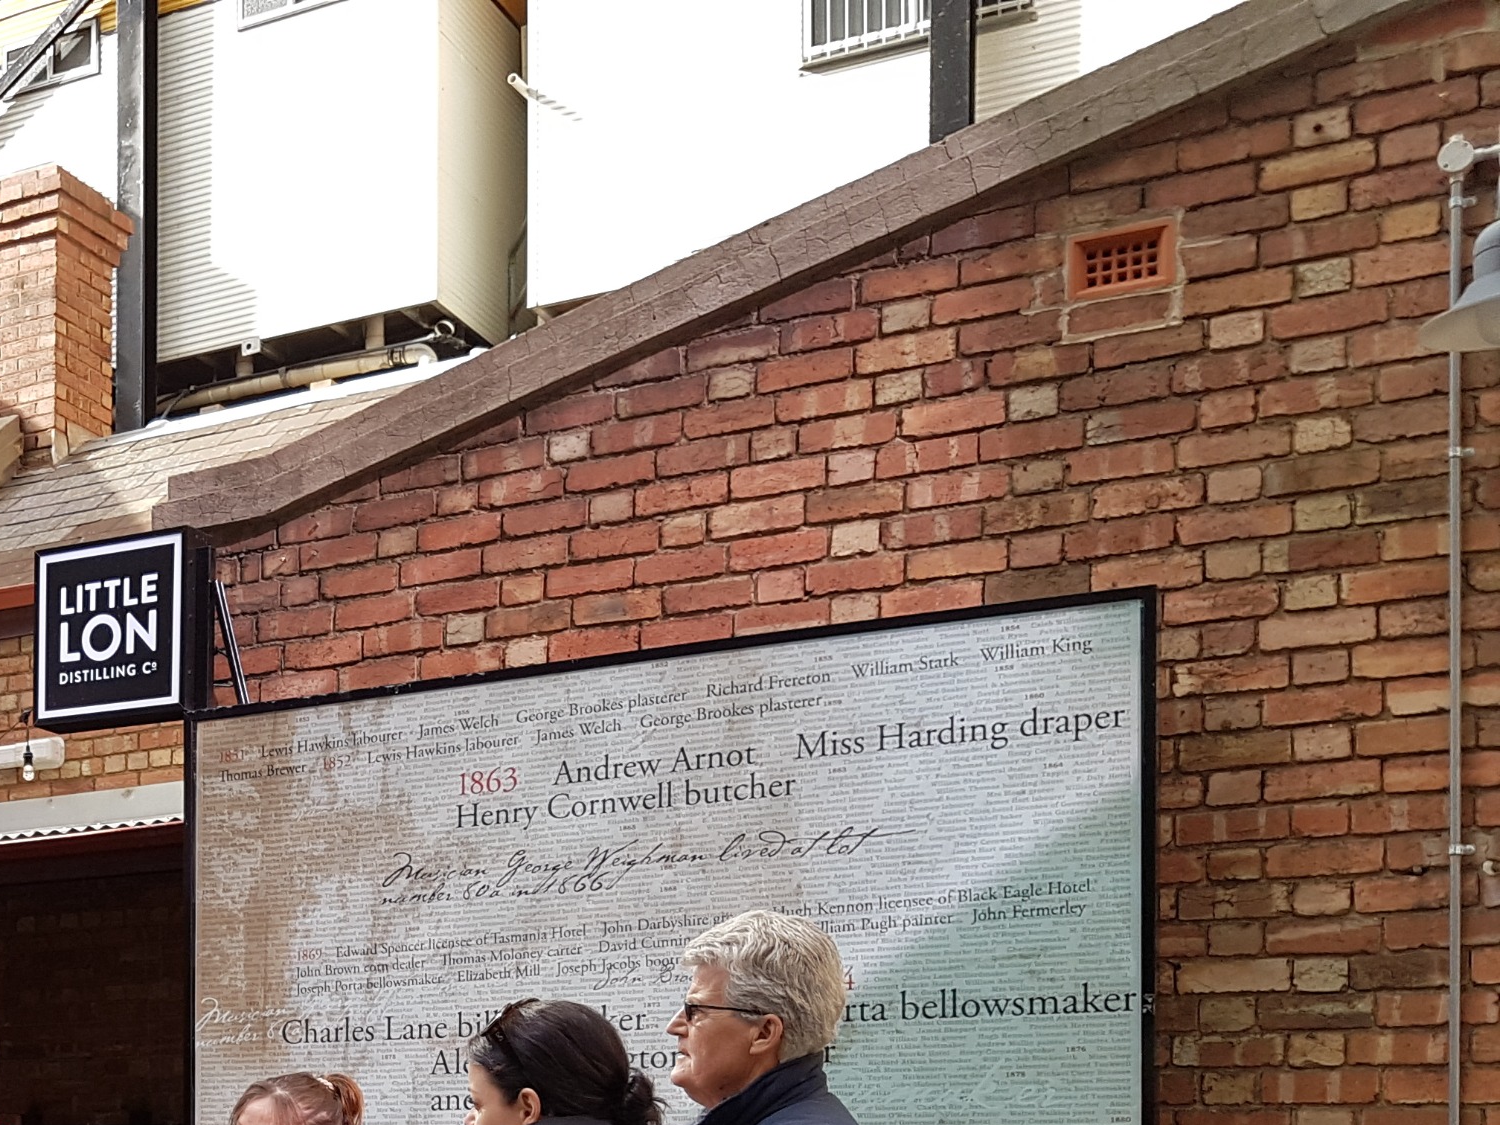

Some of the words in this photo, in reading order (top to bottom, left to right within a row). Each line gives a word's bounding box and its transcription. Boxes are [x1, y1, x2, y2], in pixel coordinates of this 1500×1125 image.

[59, 572, 159, 615] LITTLE
[59, 609, 157, 663] LON
[58, 664, 137, 685] DISTILLING
[261, 745, 293, 758] Lewis
[297, 737, 349, 755] Hawkins
[352, 729, 403, 746] labourer
[417, 723, 455, 741] James
[459, 714, 499, 731] Welch
[516, 708, 564, 724] George
[569, 698, 623, 716] Brookes
[628, 690, 687, 712] plasterer
[706, 675, 763, 697] Richard
[851, 661, 913, 678] William
[918, 652, 959, 670] Stark
[980, 642, 1045, 661] William
[1052, 637, 1093, 654] King
[219, 769, 263, 783] Thomas
[267, 763, 307, 778] Brewer
[323, 755, 351, 771] 1852
[367, 748, 401, 765] Lewis
[405, 741, 461, 760] Hawkins
[464, 734, 519, 753] labourer
[535, 727, 574, 746] James
[578, 718, 621, 736] Welch
[640, 713, 691, 728] George
[696, 702, 754, 721] Brookes
[759, 696, 822, 717] plasterer
[458, 767, 518, 796] 1863
[552, 754, 661, 786] Andrew
[671, 746, 756, 773] Arnot
[795, 731, 864, 759] Miss
[877, 716, 1008, 749] Harding
[1020, 707, 1125, 741] draper
[456, 802, 538, 830] Henry
[548, 782, 673, 819] Cornwell
[685, 772, 796, 806] butcher
[497, 850, 573, 888] George
[296, 966, 321, 980] John
[325, 963, 360, 977] Brown
[392, 957, 425, 972] dealer
[442, 953, 486, 967] Thomas
[490, 949, 543, 966] Moloney
[546, 945, 583, 958] carter
[599, 938, 637, 953] David
[641, 935, 692, 951] Cunnin
[816, 920, 855, 934] lliam
[861, 915, 897, 933] Pugh
[902, 914, 955, 932] painter
[971, 907, 1007, 925] John
[1012, 901, 1086, 920] Fermerley
[336, 942, 377, 958] Edward
[381, 938, 424, 957] Spencer
[476, 931, 490, 945] of
[492, 929, 547, 945] Tasmania
[551, 924, 586, 939] Hotel
[602, 921, 634, 937] John
[637, 912, 709, 933] Darbyshire
[818, 901, 873, 916] Kennon
[879, 895, 933, 911] licensee
[938, 889, 955, 904] of
[957, 886, 997, 903] Black
[1003, 882, 1043, 900] Eagle
[1048, 877, 1092, 895] Hotel
[296, 980, 331, 996] Joseph
[335, 978, 362, 992] Porta
[366, 973, 442, 990] bellowsmaker
[457, 967, 510, 982] Elizabeth
[515, 963, 540, 979] Mill
[555, 959, 597, 977] Joseph
[599, 956, 641, 974] Jacobs
[282, 1016, 375, 1045] Charles
[384, 1014, 447, 1041] Lane
[843, 1002, 888, 1022] rta
[900, 983, 1136, 1022] bellowsmaker
